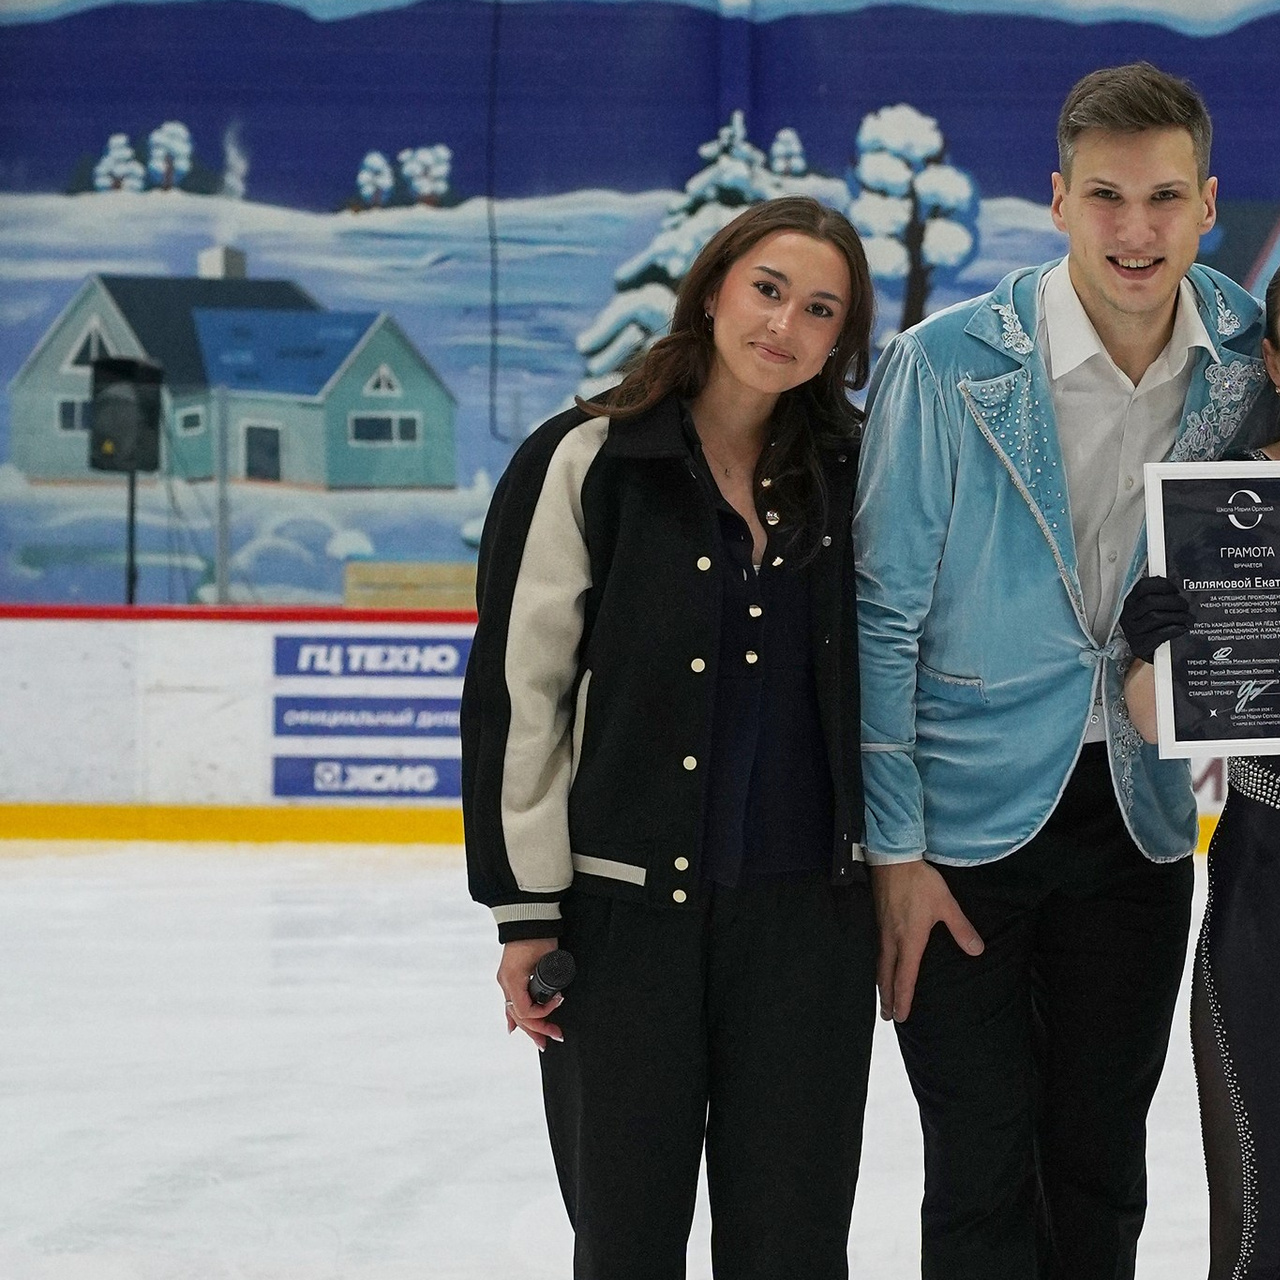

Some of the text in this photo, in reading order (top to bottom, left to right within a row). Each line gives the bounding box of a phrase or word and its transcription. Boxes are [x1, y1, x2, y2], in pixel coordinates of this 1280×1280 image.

[1220, 546, 1275, 558] ГРАМОТА
[1183, 577, 1252, 589] Галлямовой
[297, 644, 460, 675] ГЦ ТЕХНО
